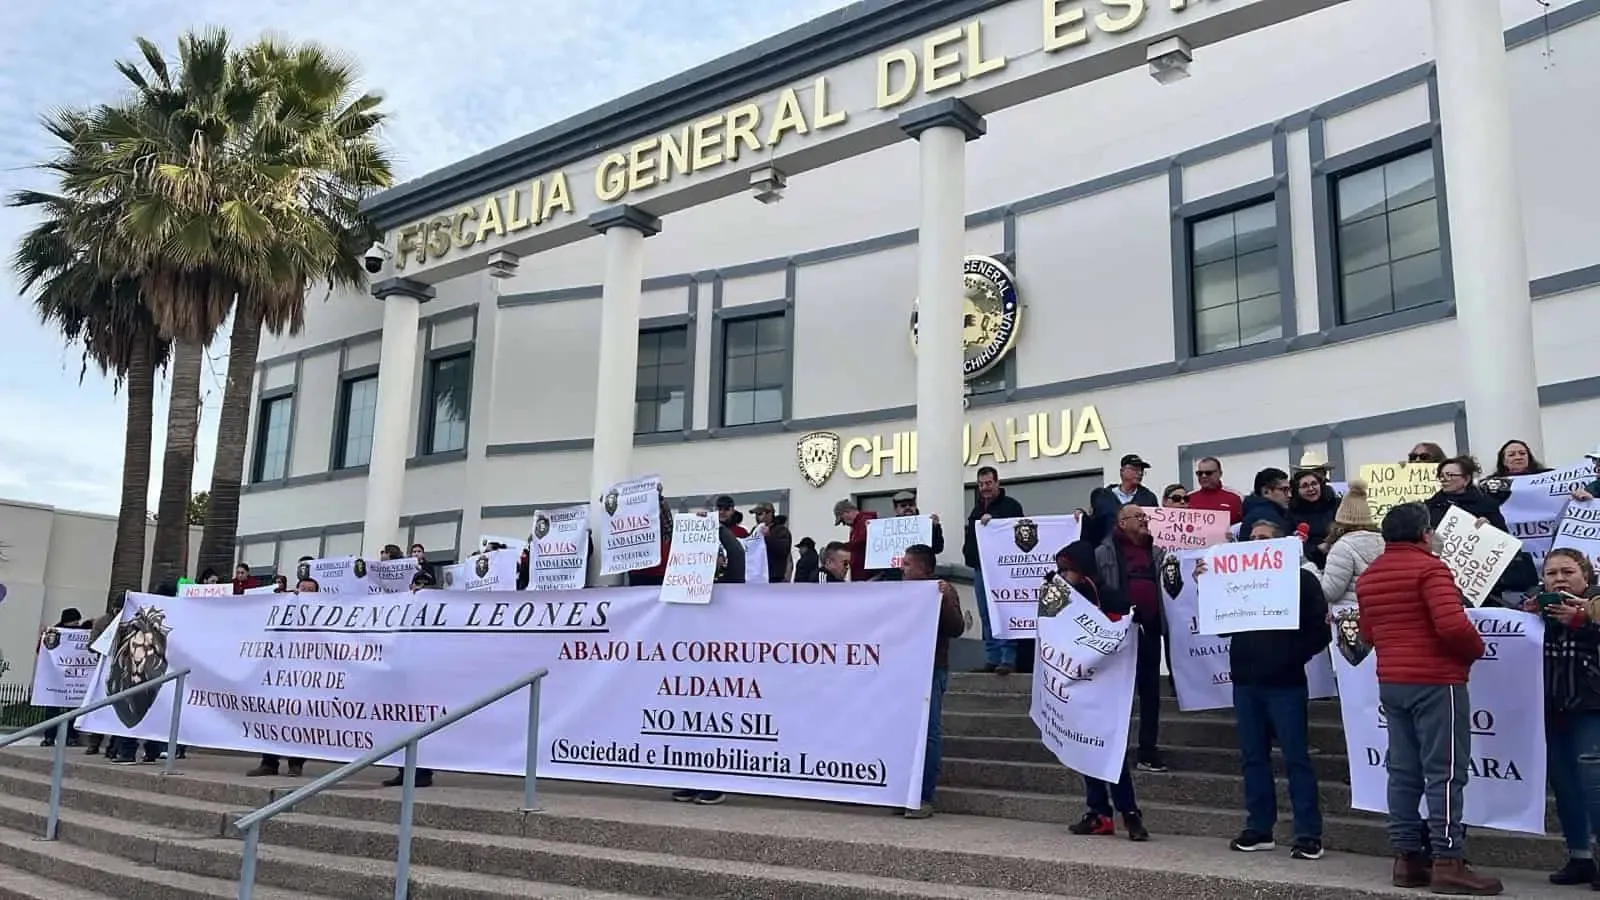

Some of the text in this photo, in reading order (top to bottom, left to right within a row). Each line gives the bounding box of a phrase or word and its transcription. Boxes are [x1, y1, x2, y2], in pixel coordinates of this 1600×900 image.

[396, 0, 1188, 270] FISCALIA GENERAL DEL ES
[964, 260, 1010, 297] GENERAL
[964, 311, 1014, 372] CHIHUAHUA
[1370, 467, 1395, 483] NO
[1367, 484, 1437, 498] IMPUNIDA
[610, 514, 650, 532] NO MAS
[537, 542, 577, 554] NO MAS
[999, 553, 1057, 565] RESIDENCIA
[1010, 567, 1048, 577] LEONES
[1214, 547, 1283, 574] NO MÁS
[992, 588, 1010, 600] NO
[1014, 588, 1030, 600] ES
[266, 601, 611, 627] RESIDENCIAL LEONES
[1009, 616, 1038, 629] Sera
[240, 641, 384, 662] FUERA IMPUNIDAD!!
[558, 641, 880, 666] ABAJO LA CORRUPCION EN
[261, 671, 345, 690] A FAVOR DE
[657, 676, 762, 699] ALDAMA
[188, 689, 239, 711] HECTOR
[241, 696, 302, 715] SERAPIO
[305, 697, 367, 720] MUÑOZ
[642, 708, 779, 736] NO MAS SIL
[242, 721, 374, 750] Y SUS COMPLICES
[550, 738, 887, 785] (Sociedad e Inmobiliaria Leones)
